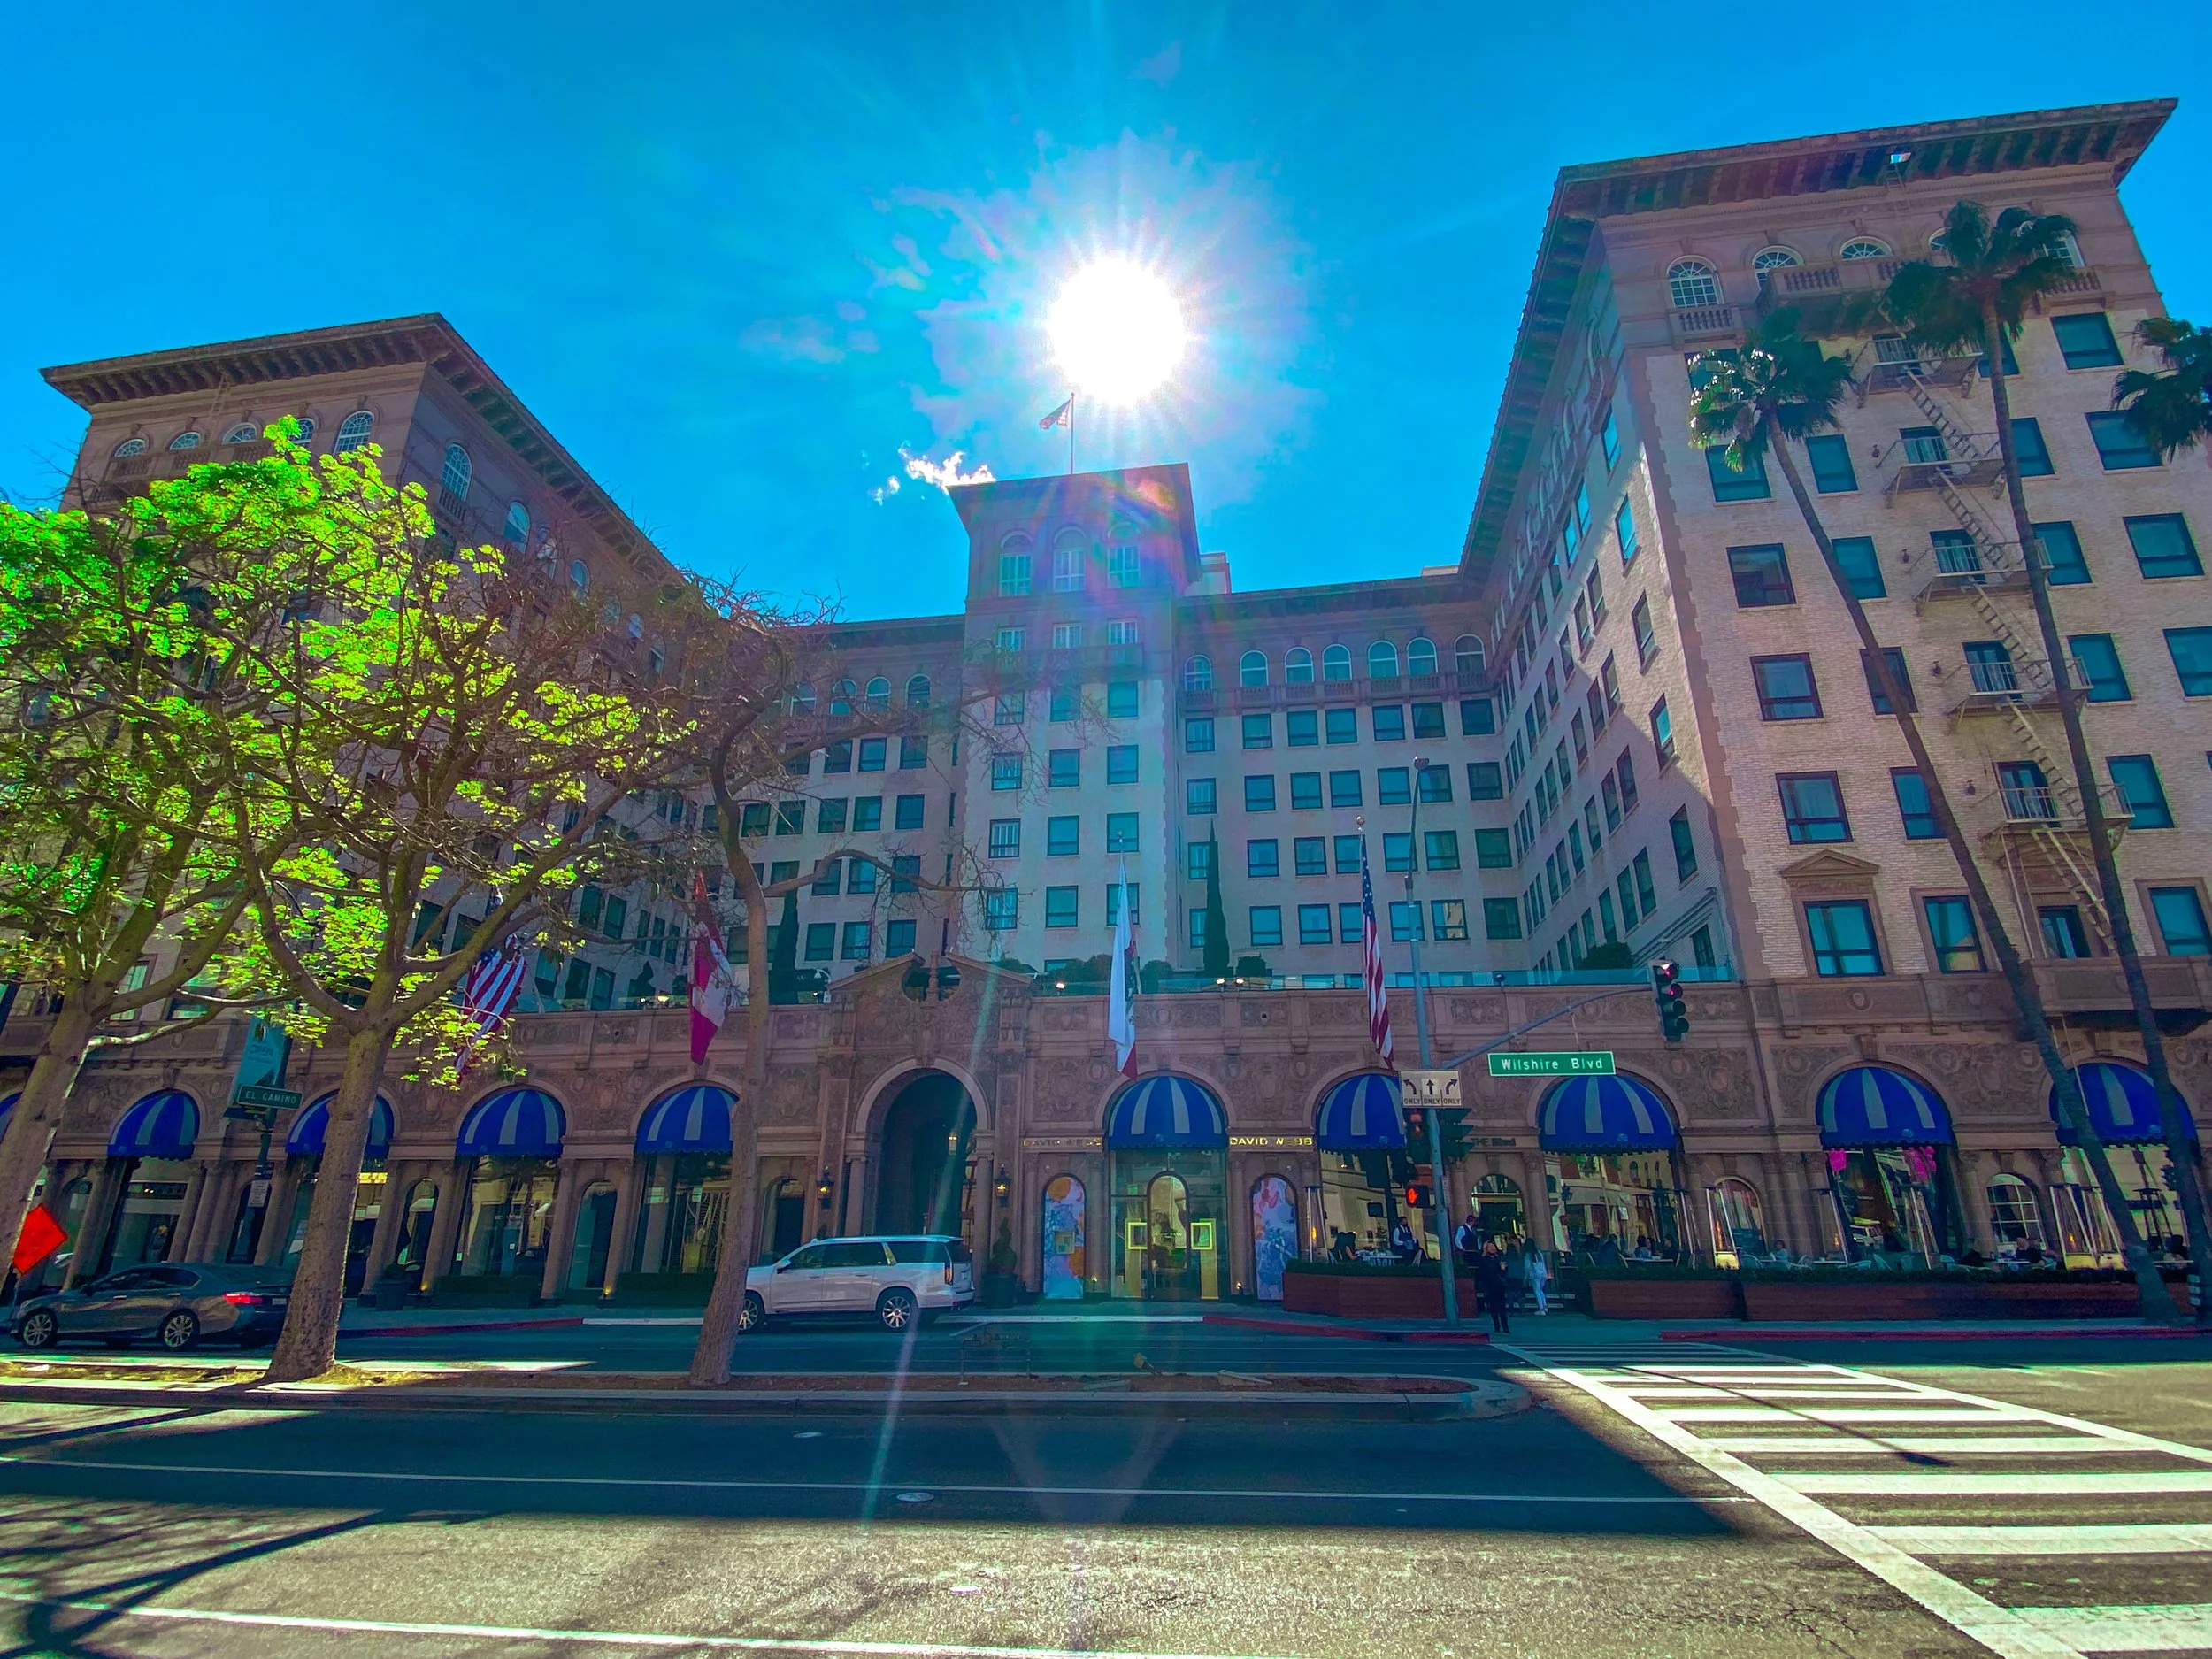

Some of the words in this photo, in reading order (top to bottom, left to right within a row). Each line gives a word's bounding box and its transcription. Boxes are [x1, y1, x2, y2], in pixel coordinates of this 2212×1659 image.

[1501, 1057, 1559, 1071] Wilshire
[1571, 1057, 1603, 1070] Blvd
[245, 1090, 256, 1100] EL
[262, 1093, 296, 1104] CAMINO
